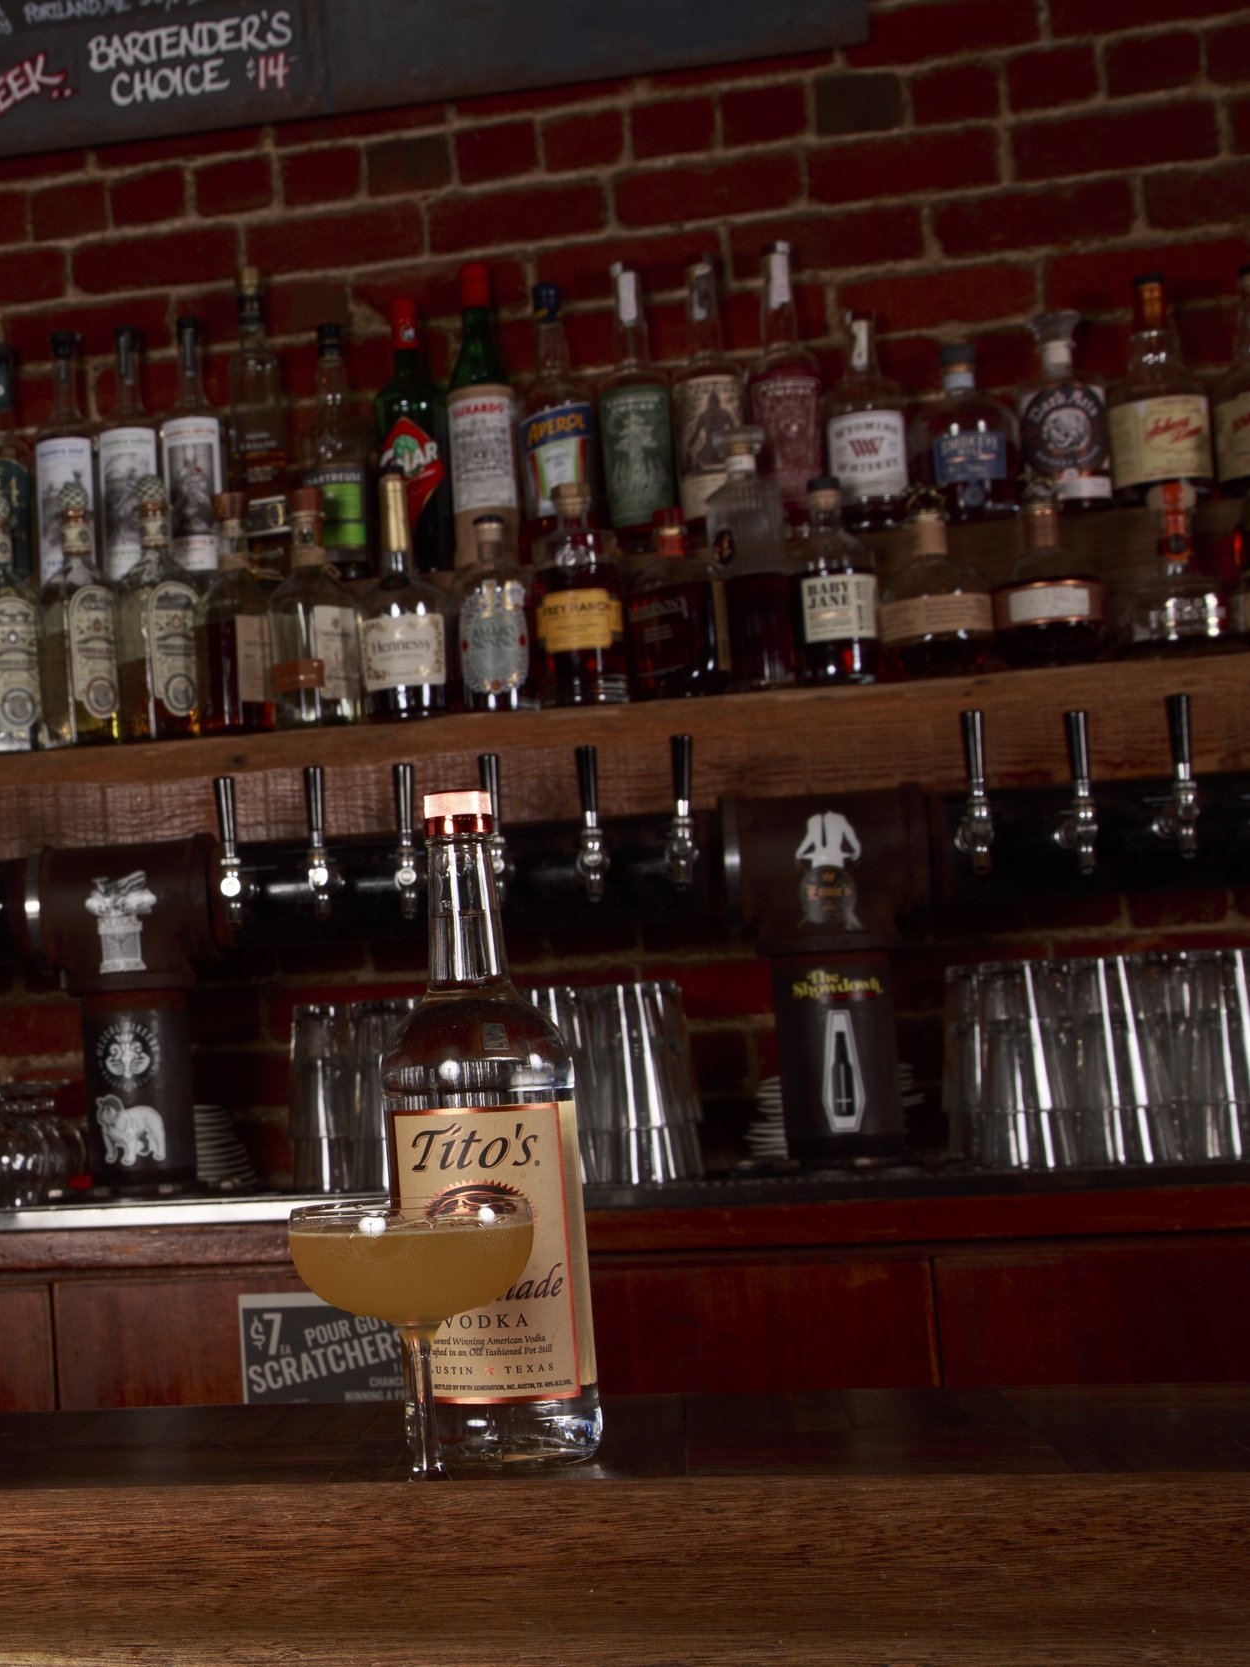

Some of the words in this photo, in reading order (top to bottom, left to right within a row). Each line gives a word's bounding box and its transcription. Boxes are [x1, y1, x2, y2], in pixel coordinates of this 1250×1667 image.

[88, 10, 292, 73] BARTENDER'S
[111, 57, 231, 107] CHOICE
[527, 413, 588, 447] APEROL
[372, 639, 432, 655] Hennessy
[410, 1122, 540, 1174] Tito's
[445, 1312, 530, 1330] VODKA
[303, 1318, 352, 1349] POUR
[452, 1337, 485, 1347] Winning
[487, 1336, 523, 1345] American
[524, 1333, 546, 1343] Vodka
[449, 1349, 457, 1357] in
[458, 1349, 467, 1357] an
[469, 1347, 483, 1357] Old
[485, 1346, 522, 1357] Fashioned
[524, 1346, 537, 1355] Pot
[538, 1344, 553, 1354] Still
[505, 1362, 554, 1375] TEXAS
[344, 1390, 384, 1402] WINNING
